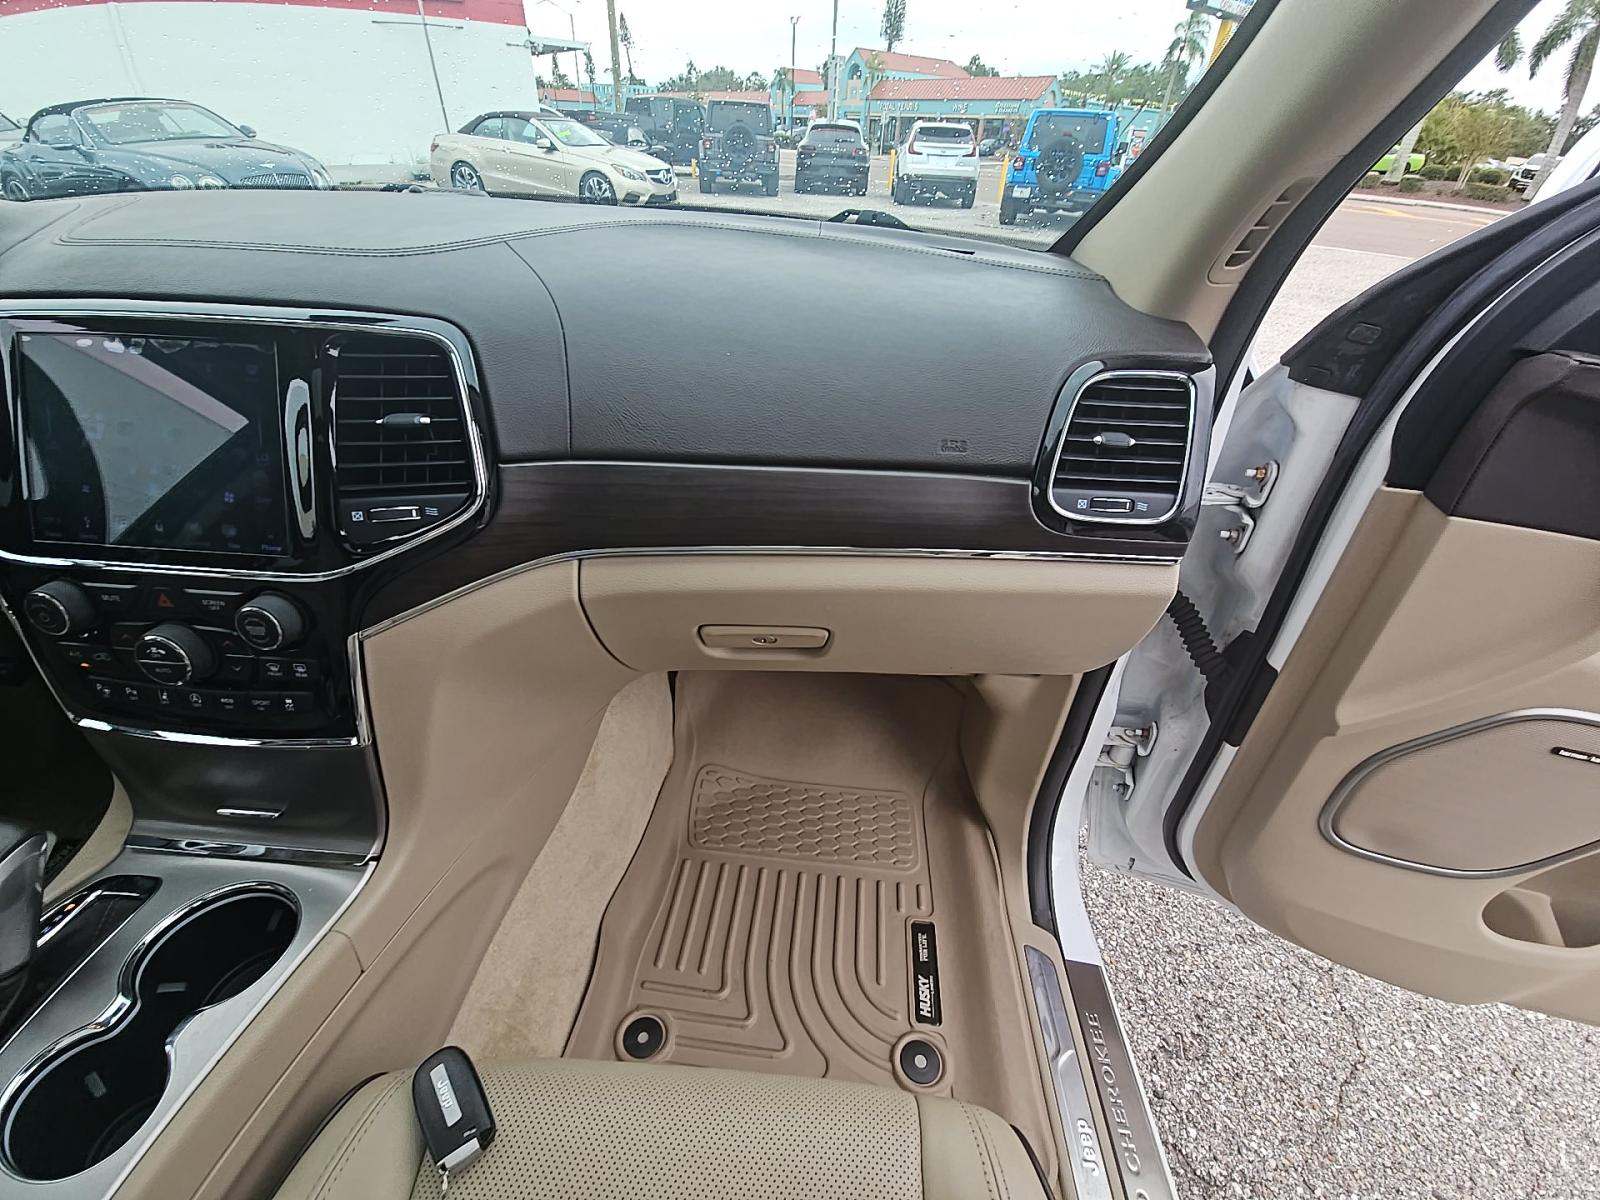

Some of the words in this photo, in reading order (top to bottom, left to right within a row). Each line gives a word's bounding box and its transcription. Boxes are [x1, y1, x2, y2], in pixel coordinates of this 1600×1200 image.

[917, 974, 932, 1018] HUSKY
[1085, 1012, 1141, 1177] CHEROKEE
[1076, 1117, 1100, 1177] Jeep
